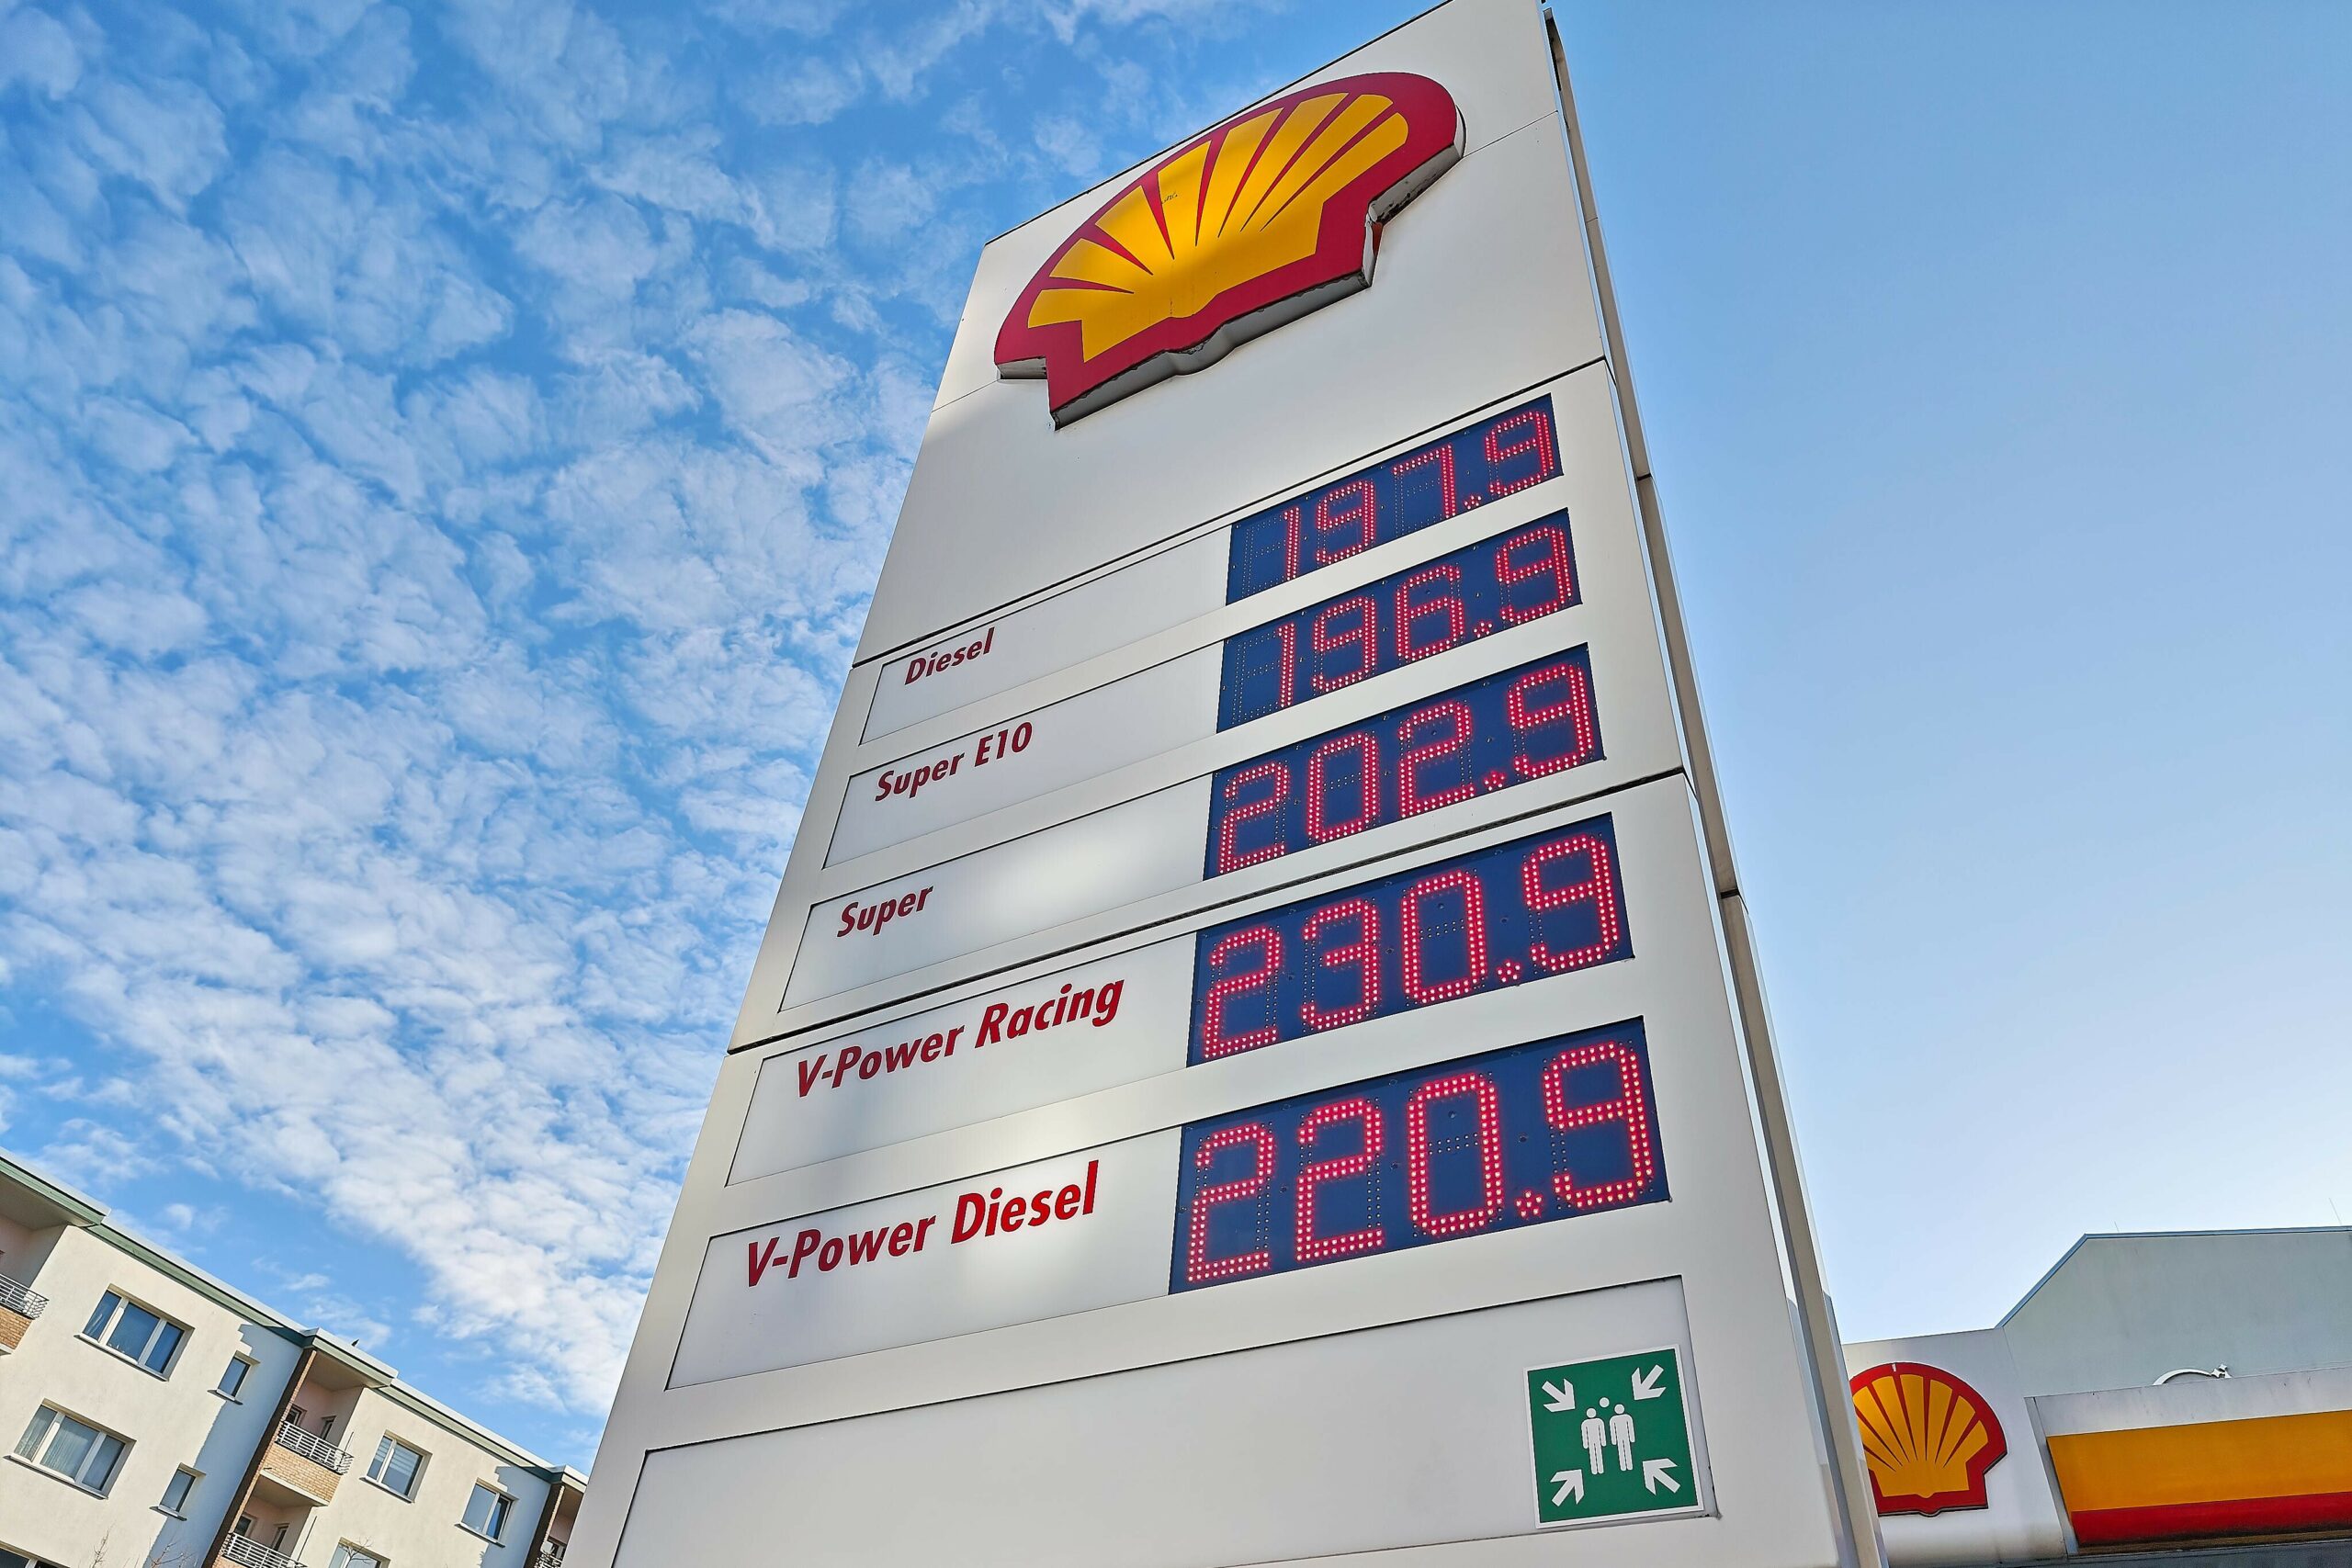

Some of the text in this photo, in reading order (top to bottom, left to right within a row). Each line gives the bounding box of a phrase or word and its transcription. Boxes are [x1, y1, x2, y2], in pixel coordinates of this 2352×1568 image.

[1283, 410, 1555, 582] 197.9
[903, 626, 996, 686] Diesel
[1277, 525, 1573, 709] 196.9
[874, 721, 1034, 803] Super E10
[1217, 662, 1594, 874] 202.9
[836, 885, 934, 938] Super
[1203, 834, 1620, 1060] 230.9
[797, 979, 1125, 1098] V-Power Racing
[747, 1158, 1100, 1288] V-Power Diesel
[1186, 1041, 1654, 1283] 220.9
